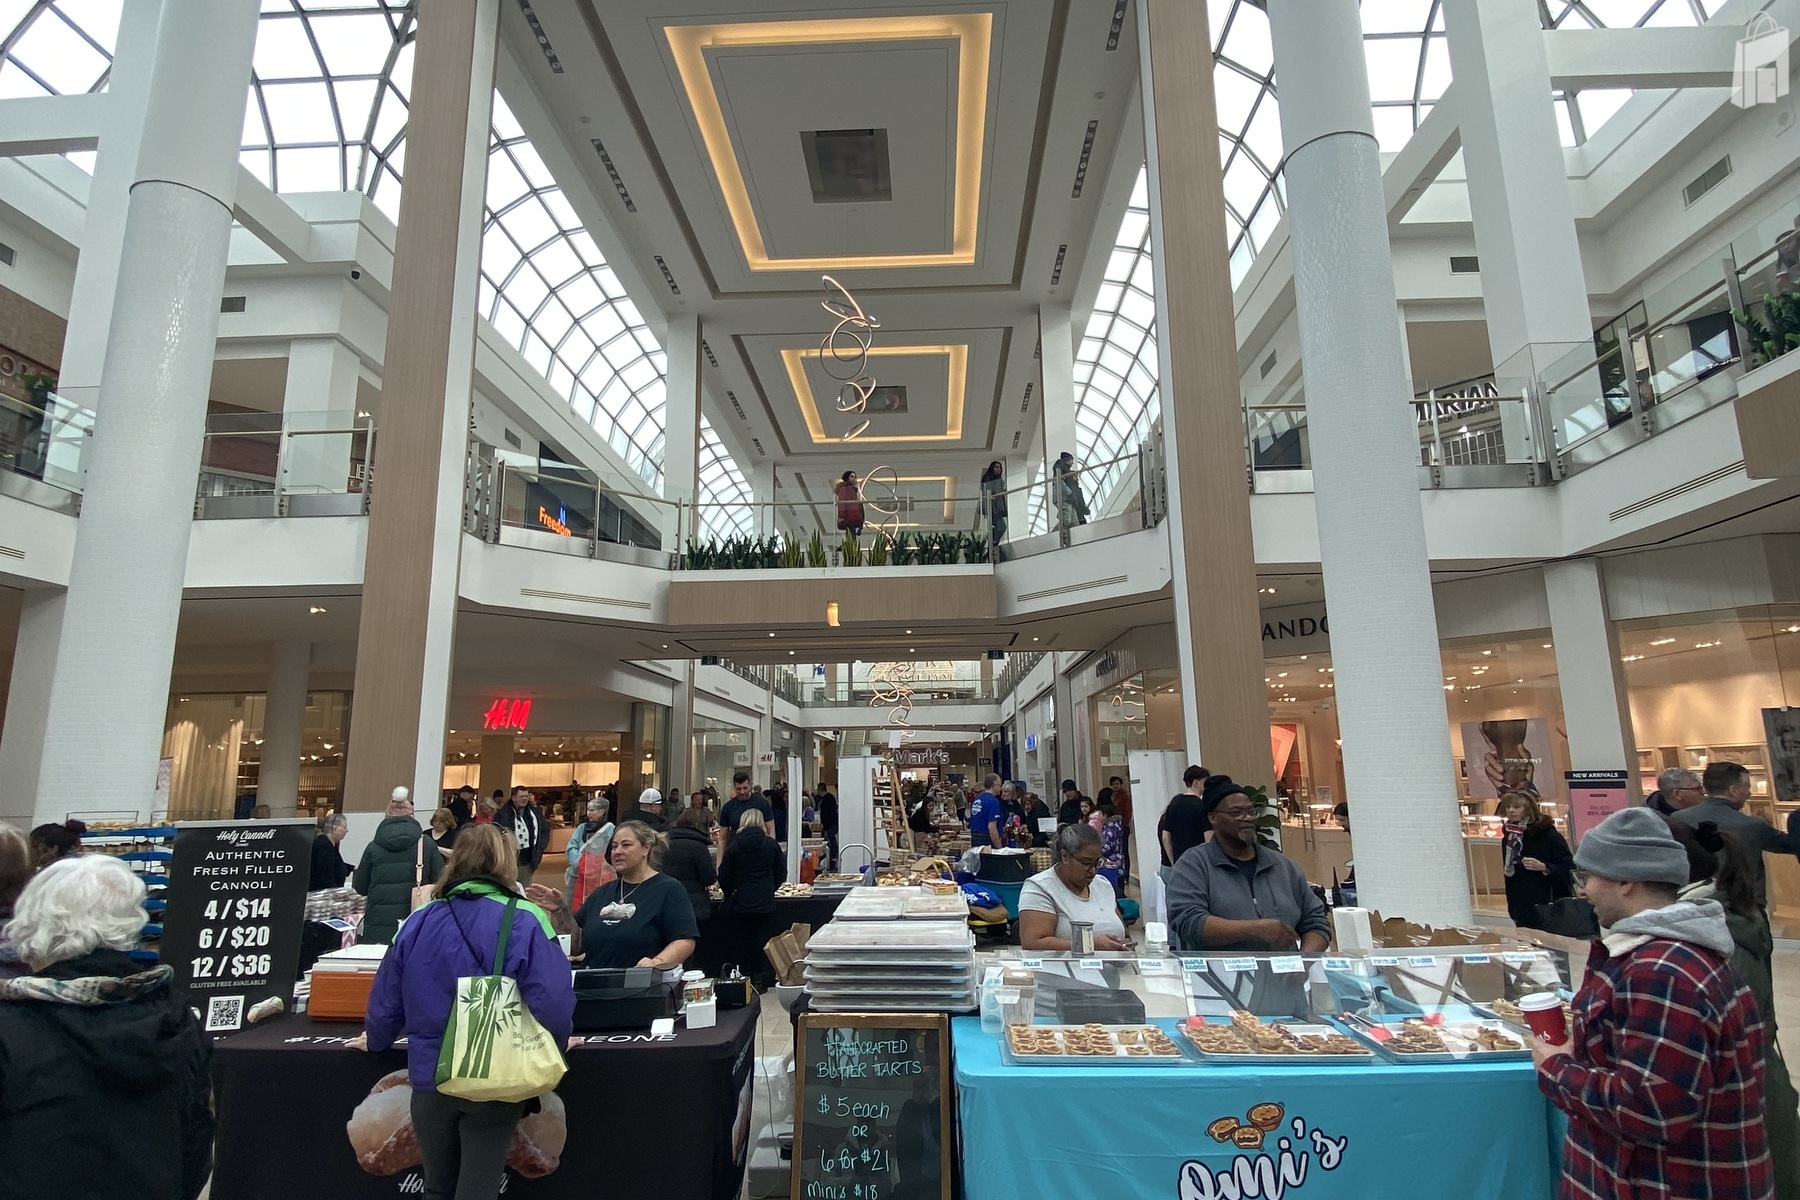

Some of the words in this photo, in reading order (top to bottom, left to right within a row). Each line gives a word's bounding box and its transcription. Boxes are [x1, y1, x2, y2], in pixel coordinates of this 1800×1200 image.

[539, 505, 572, 537] Freedom
[484, 698, 531, 730] H&M
[894, 749, 950, 765] Mark's
[216, 830, 240, 844] Holy
[240, 829, 276, 841] Cannoli
[205, 850, 286, 861] AUTHENTIC
[193, 866, 239, 876] FRESH
[245, 865, 294, 875] FILLED
[210, 880, 273, 891] CANNOLI
[204, 900, 218, 920] 4
[235, 898, 271, 920] $14
[198, 928, 214, 949] 6
[230, 926, 271, 949] $20
[190, 956, 214, 978] 12
[231, 954, 271, 978] $36
[824, 1037, 908, 1056] HANDCRAFTED
[816, 1061, 867, 1080] BUTTER
[871, 1060, 922, 1077] TARTS
[852, 1125, 868, 1138] OR
[838, 1148, 858, 1170] for
[1178, 1115, 1349, 1200] Omi's
[854, 1183, 878, 1200] $18
